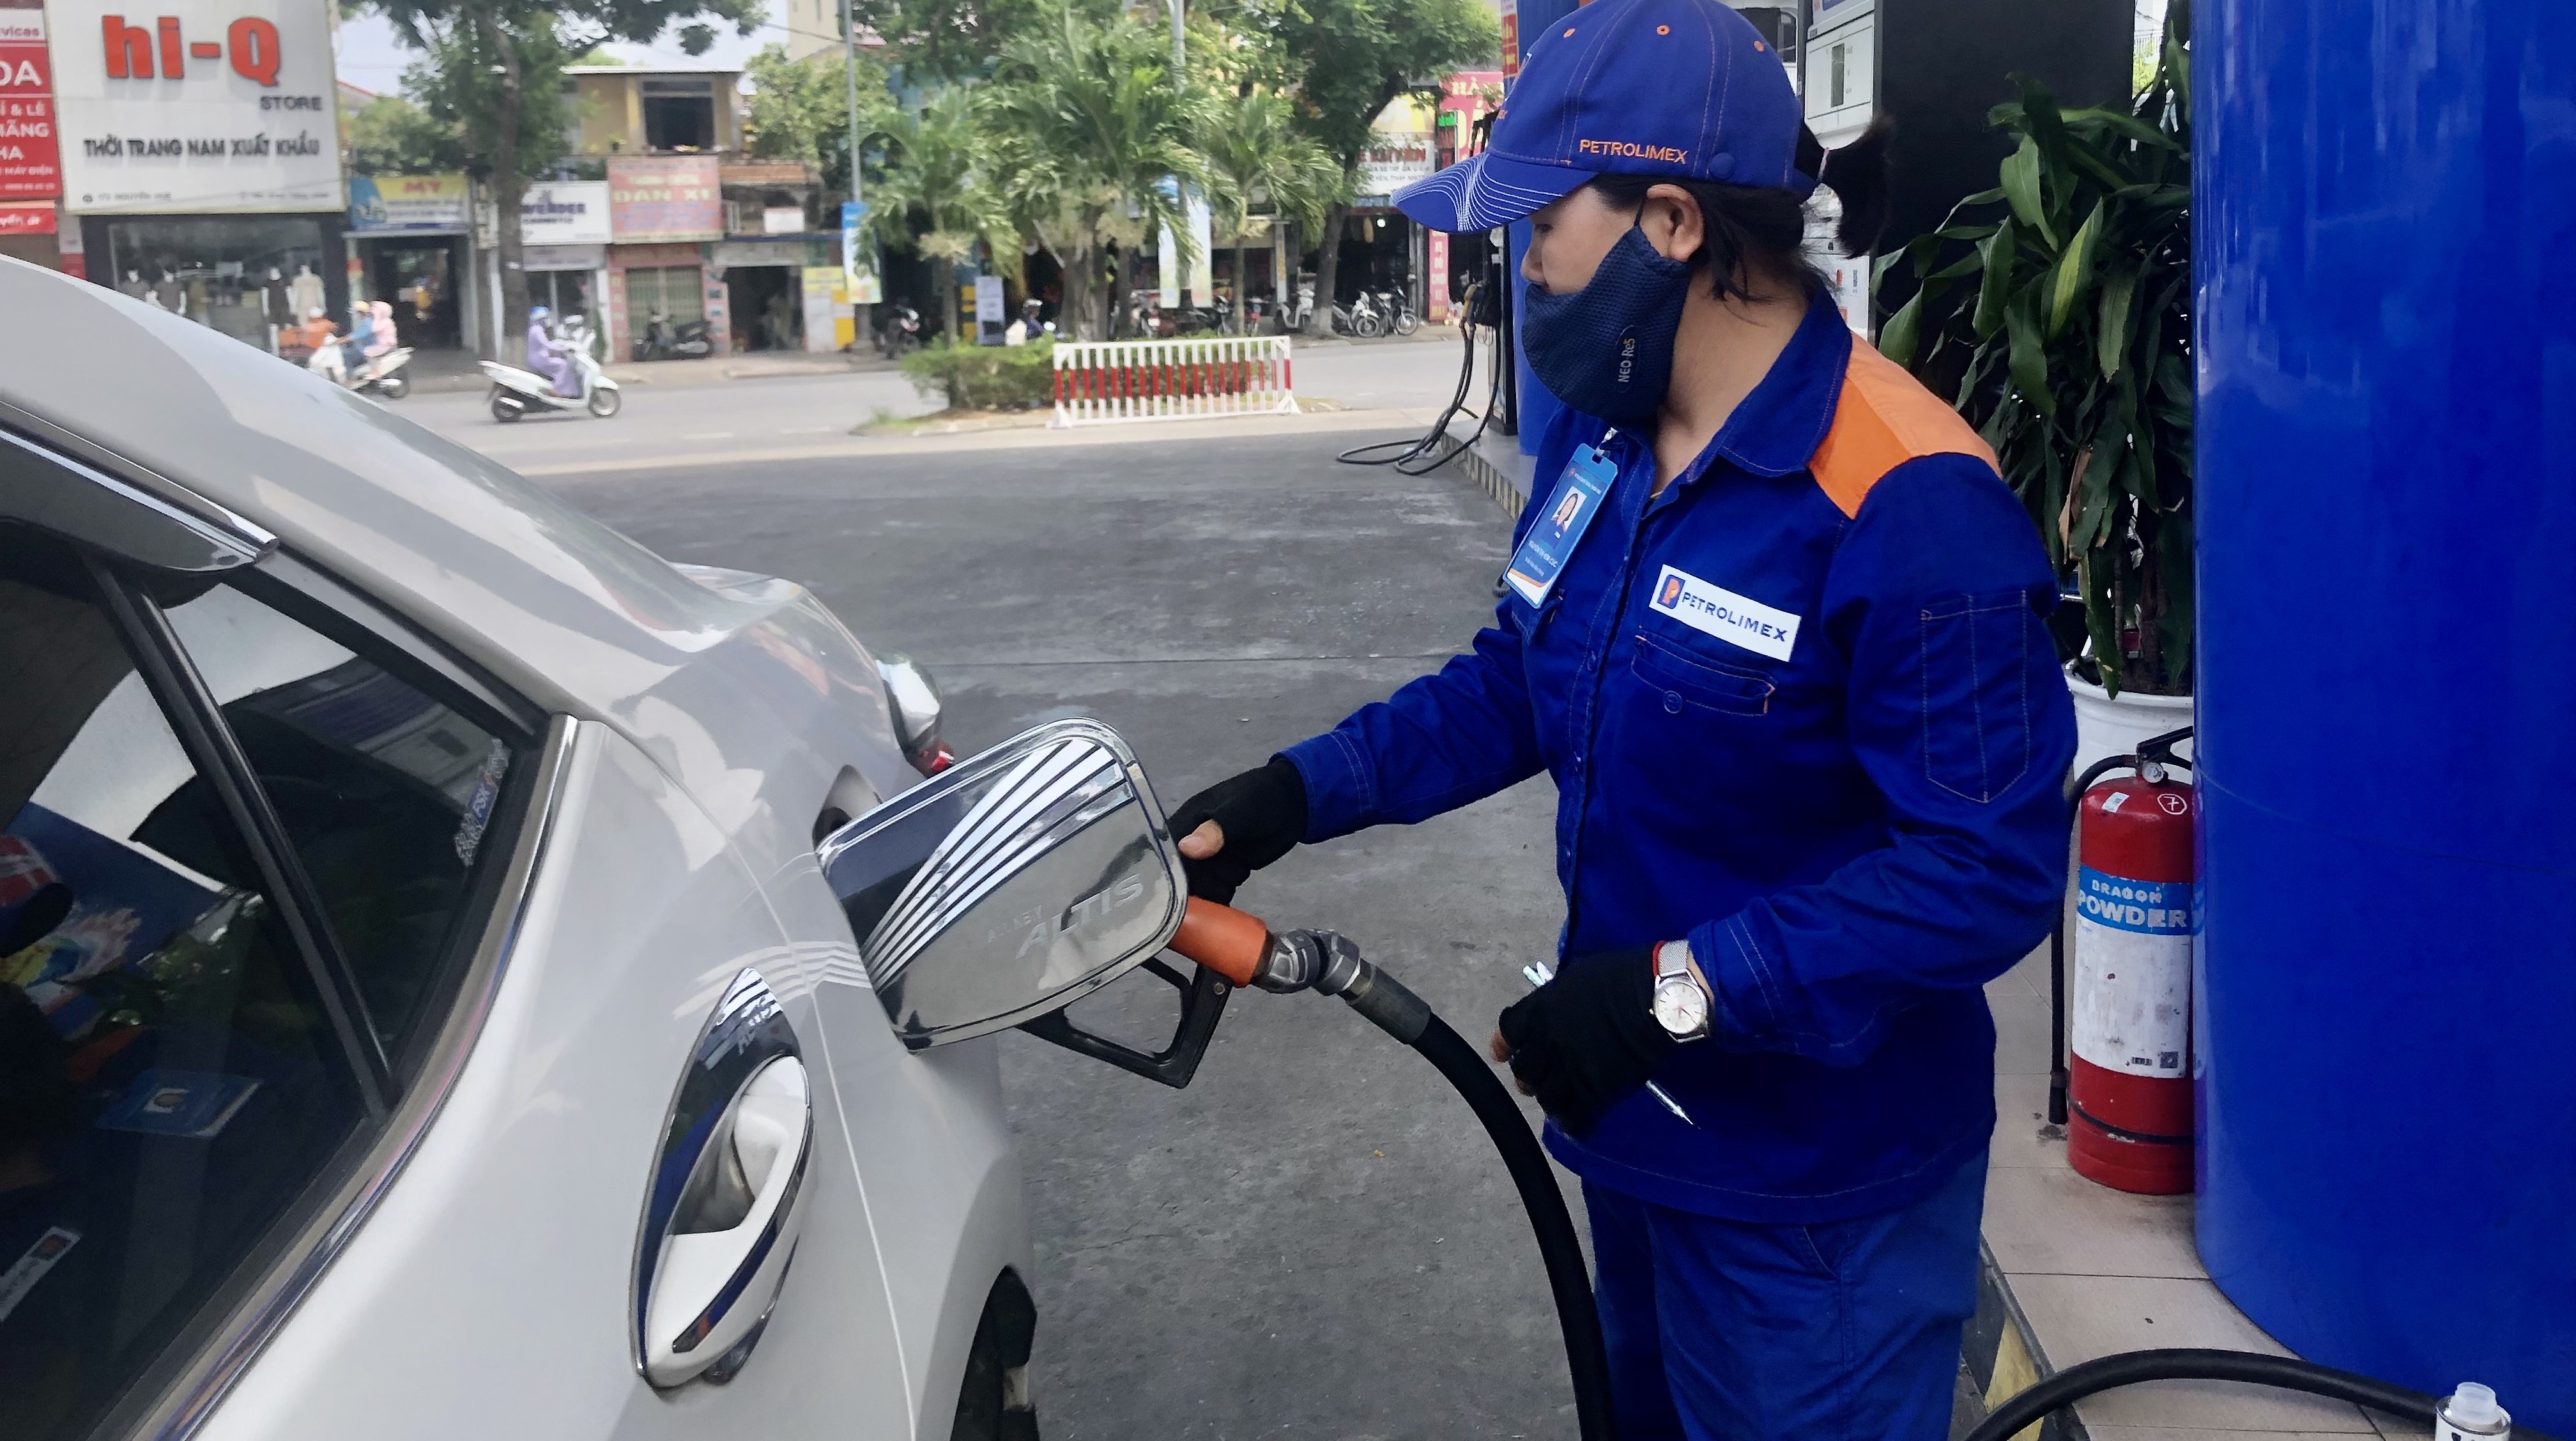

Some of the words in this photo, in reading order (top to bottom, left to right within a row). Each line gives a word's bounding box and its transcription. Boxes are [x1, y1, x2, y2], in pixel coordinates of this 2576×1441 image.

[102, 15, 280, 86] hi-Q
[260, 96, 321, 110] STORE
[126, 138, 183, 155] TRANG
[187, 138, 226, 155] NAM
[1579, 139, 1688, 165] PETROLIMEX
[1682, 591, 1788, 642] PETROLIMEX
[1016, 873, 1144, 959] ALTIS
[2078, 891, 2187, 927] POWDER
